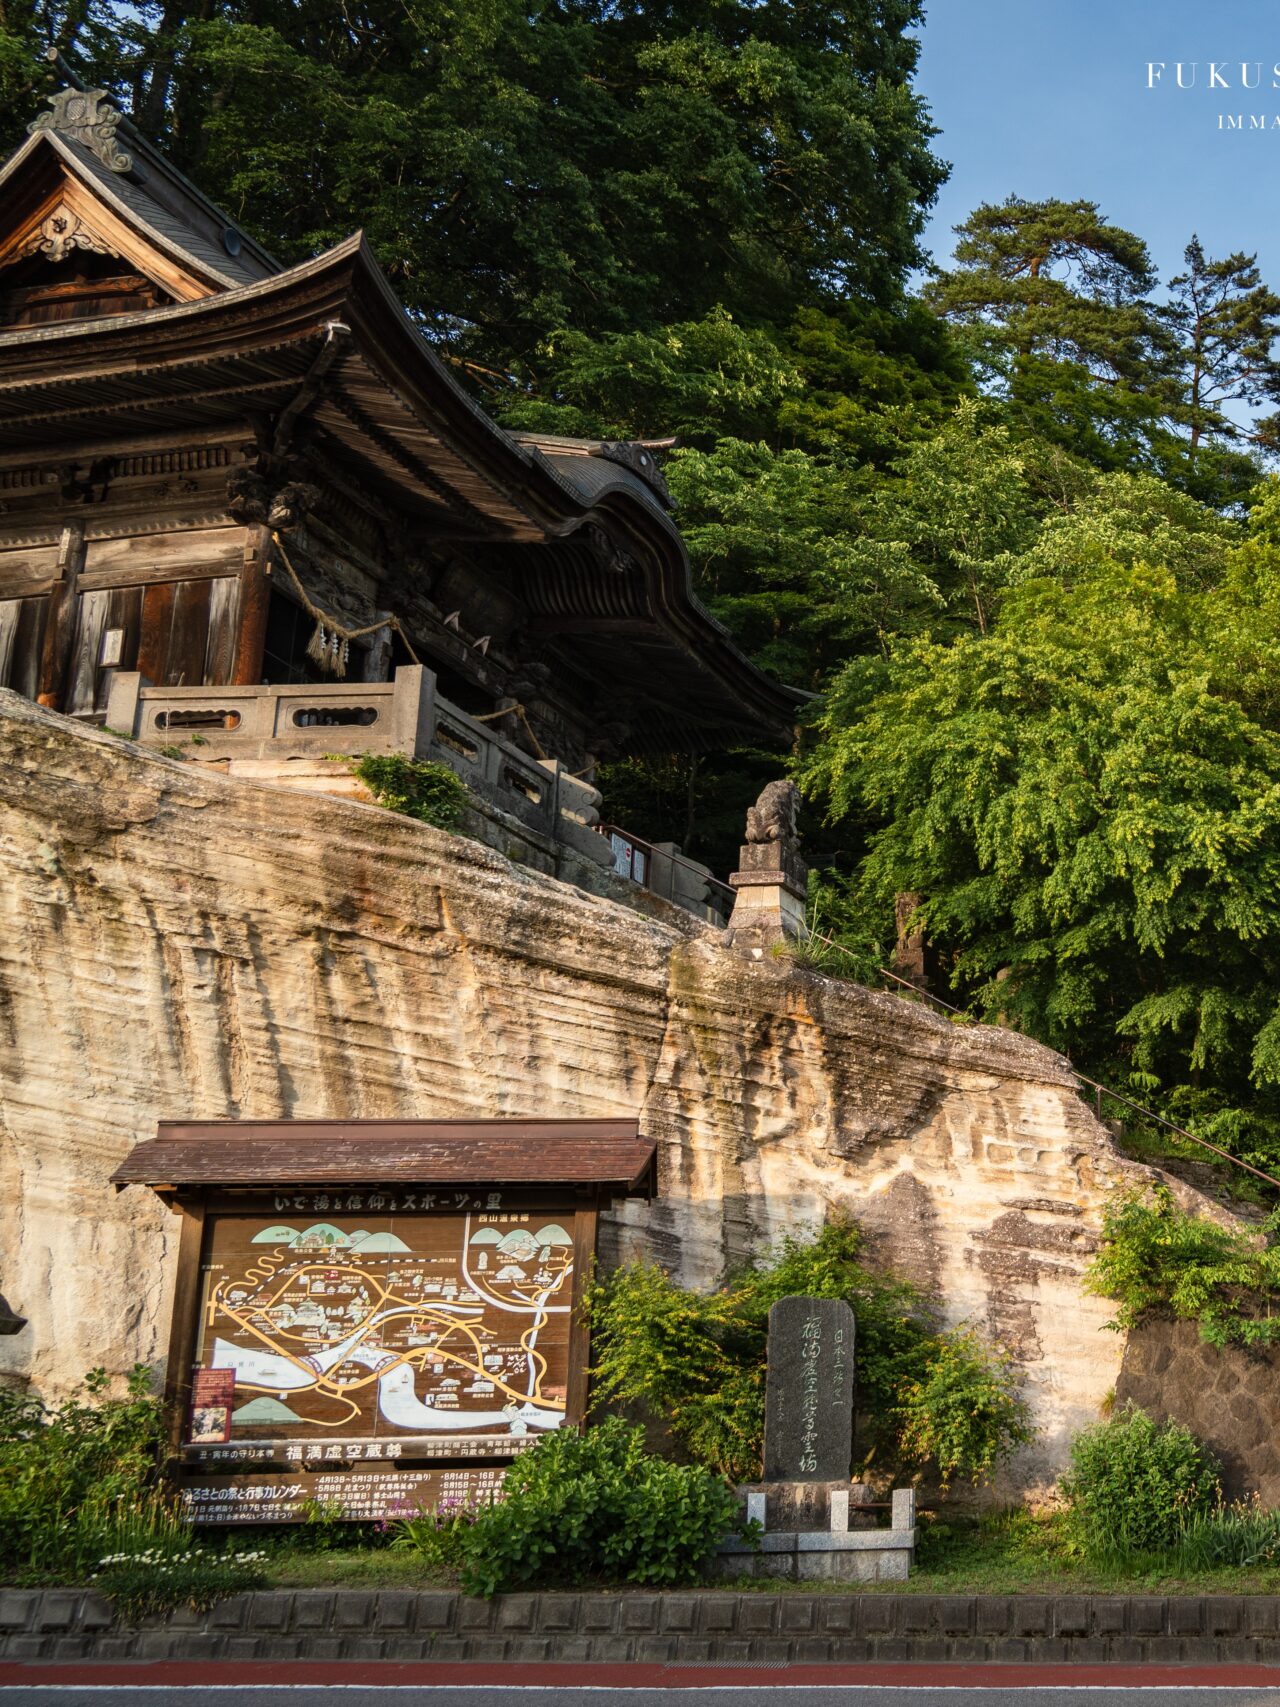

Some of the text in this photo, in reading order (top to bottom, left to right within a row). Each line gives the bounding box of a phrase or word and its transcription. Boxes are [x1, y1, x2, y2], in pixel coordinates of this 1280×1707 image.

[274, 1193, 502, 1211] いで湯と信仰とスポーツの里
